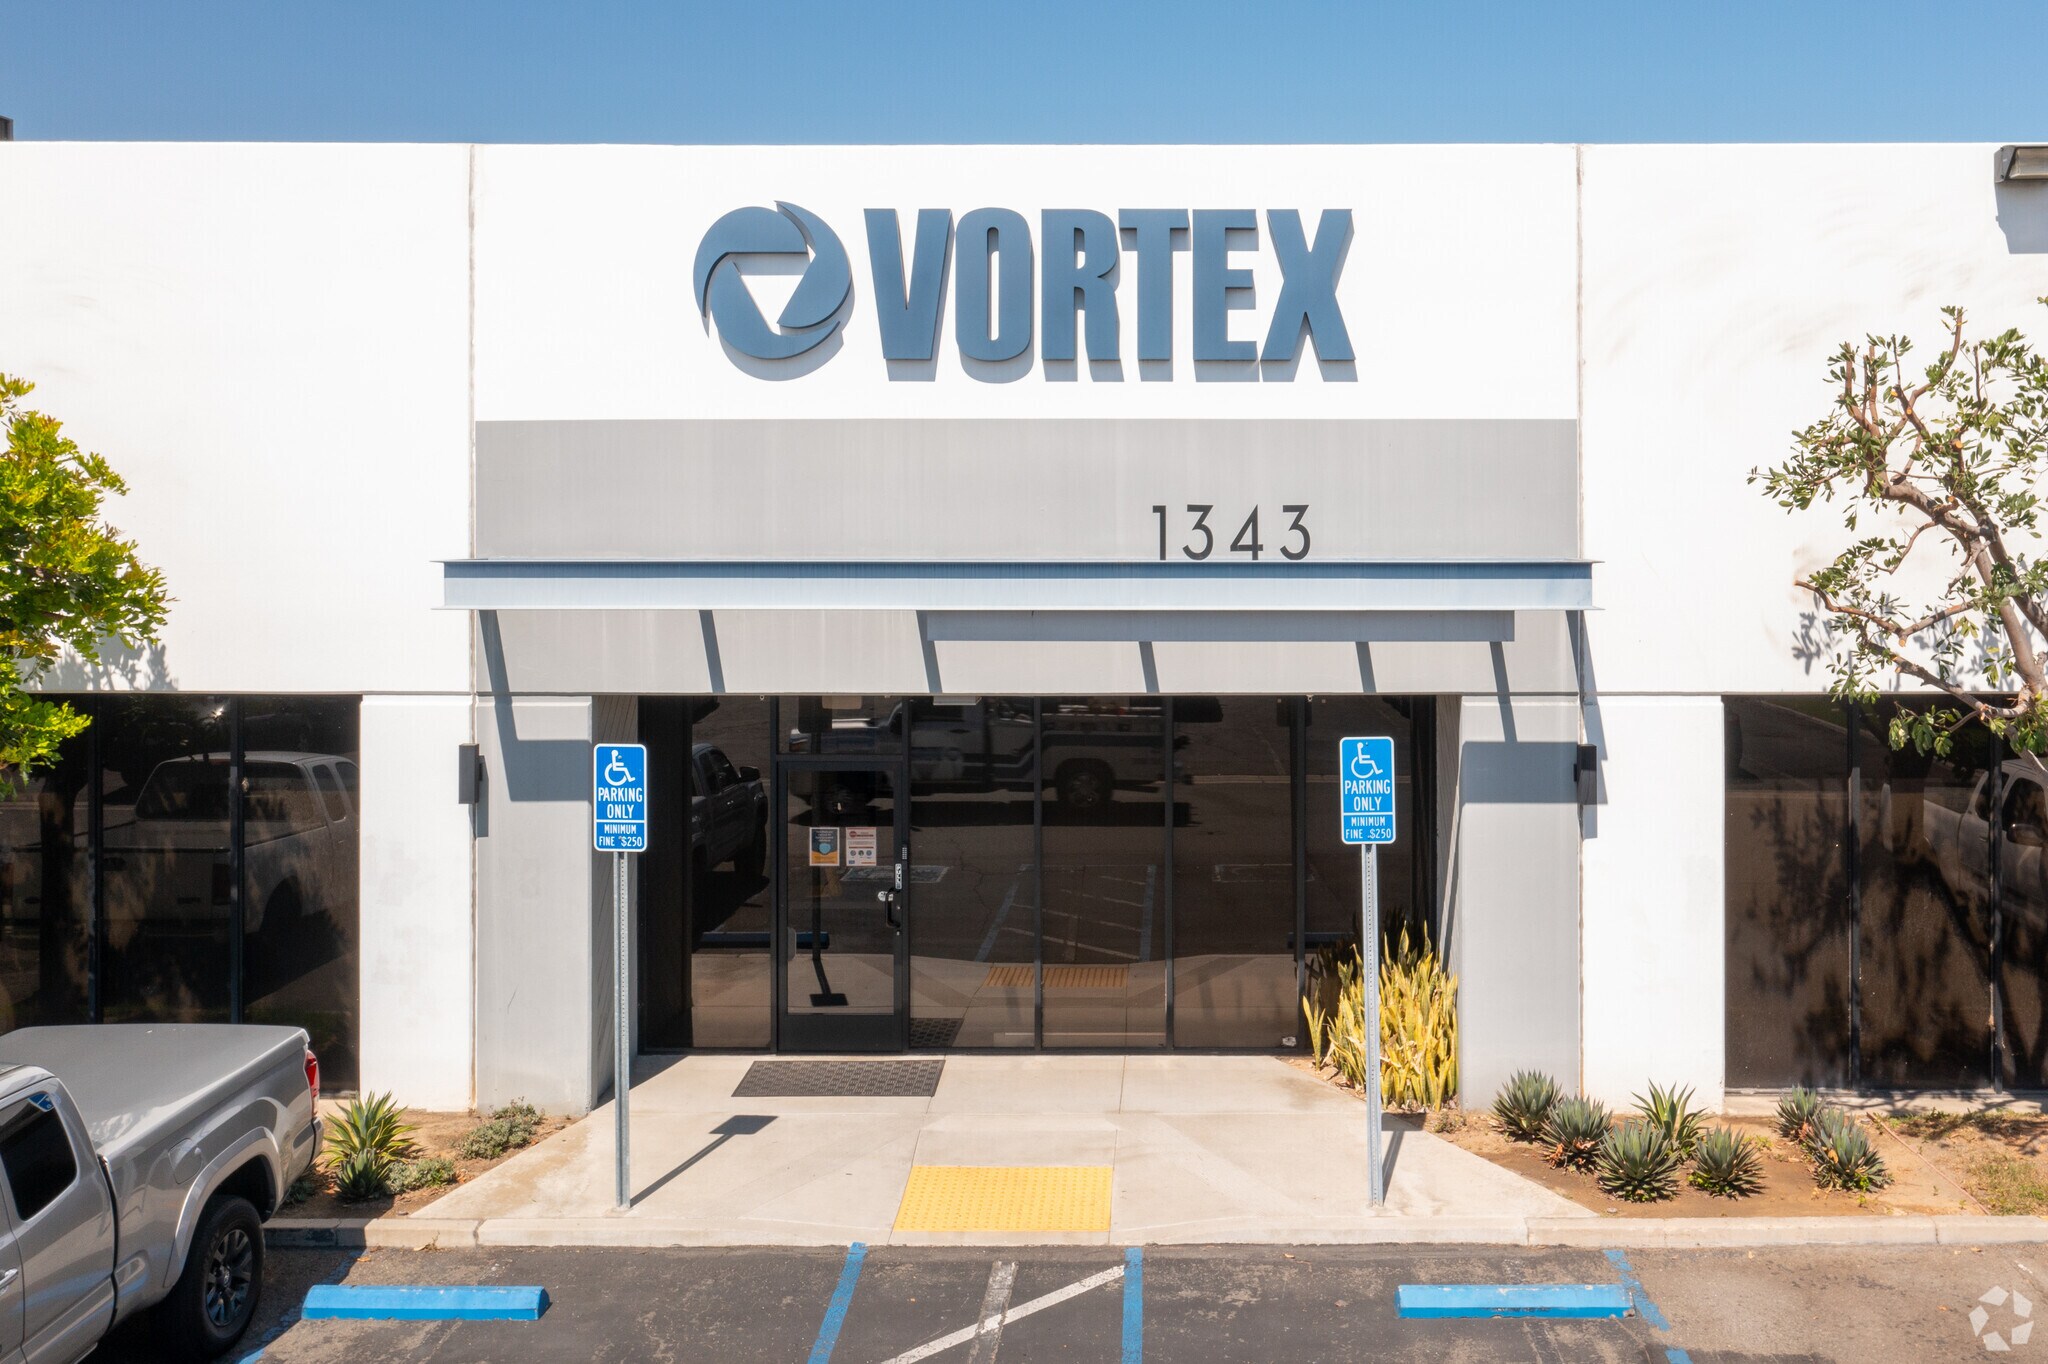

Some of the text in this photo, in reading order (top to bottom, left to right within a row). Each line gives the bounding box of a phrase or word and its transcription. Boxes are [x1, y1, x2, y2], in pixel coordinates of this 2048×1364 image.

[864, 207, 1356, 364] VORTEX
[1152, 504, 1311, 562] 1343
[1344, 779, 1390, 794] PARKING
[598, 787, 643, 802] PARKING
[1354, 796, 1382, 811] ONLY
[607, 804, 634, 818] ONLY
[1351, 816, 1385, 826] MINIMUM
[604, 824, 637, 834] MINIMUM
[1346, 828, 1391, 839] FINE $250
[599, 836, 642, 847] FINE $250
